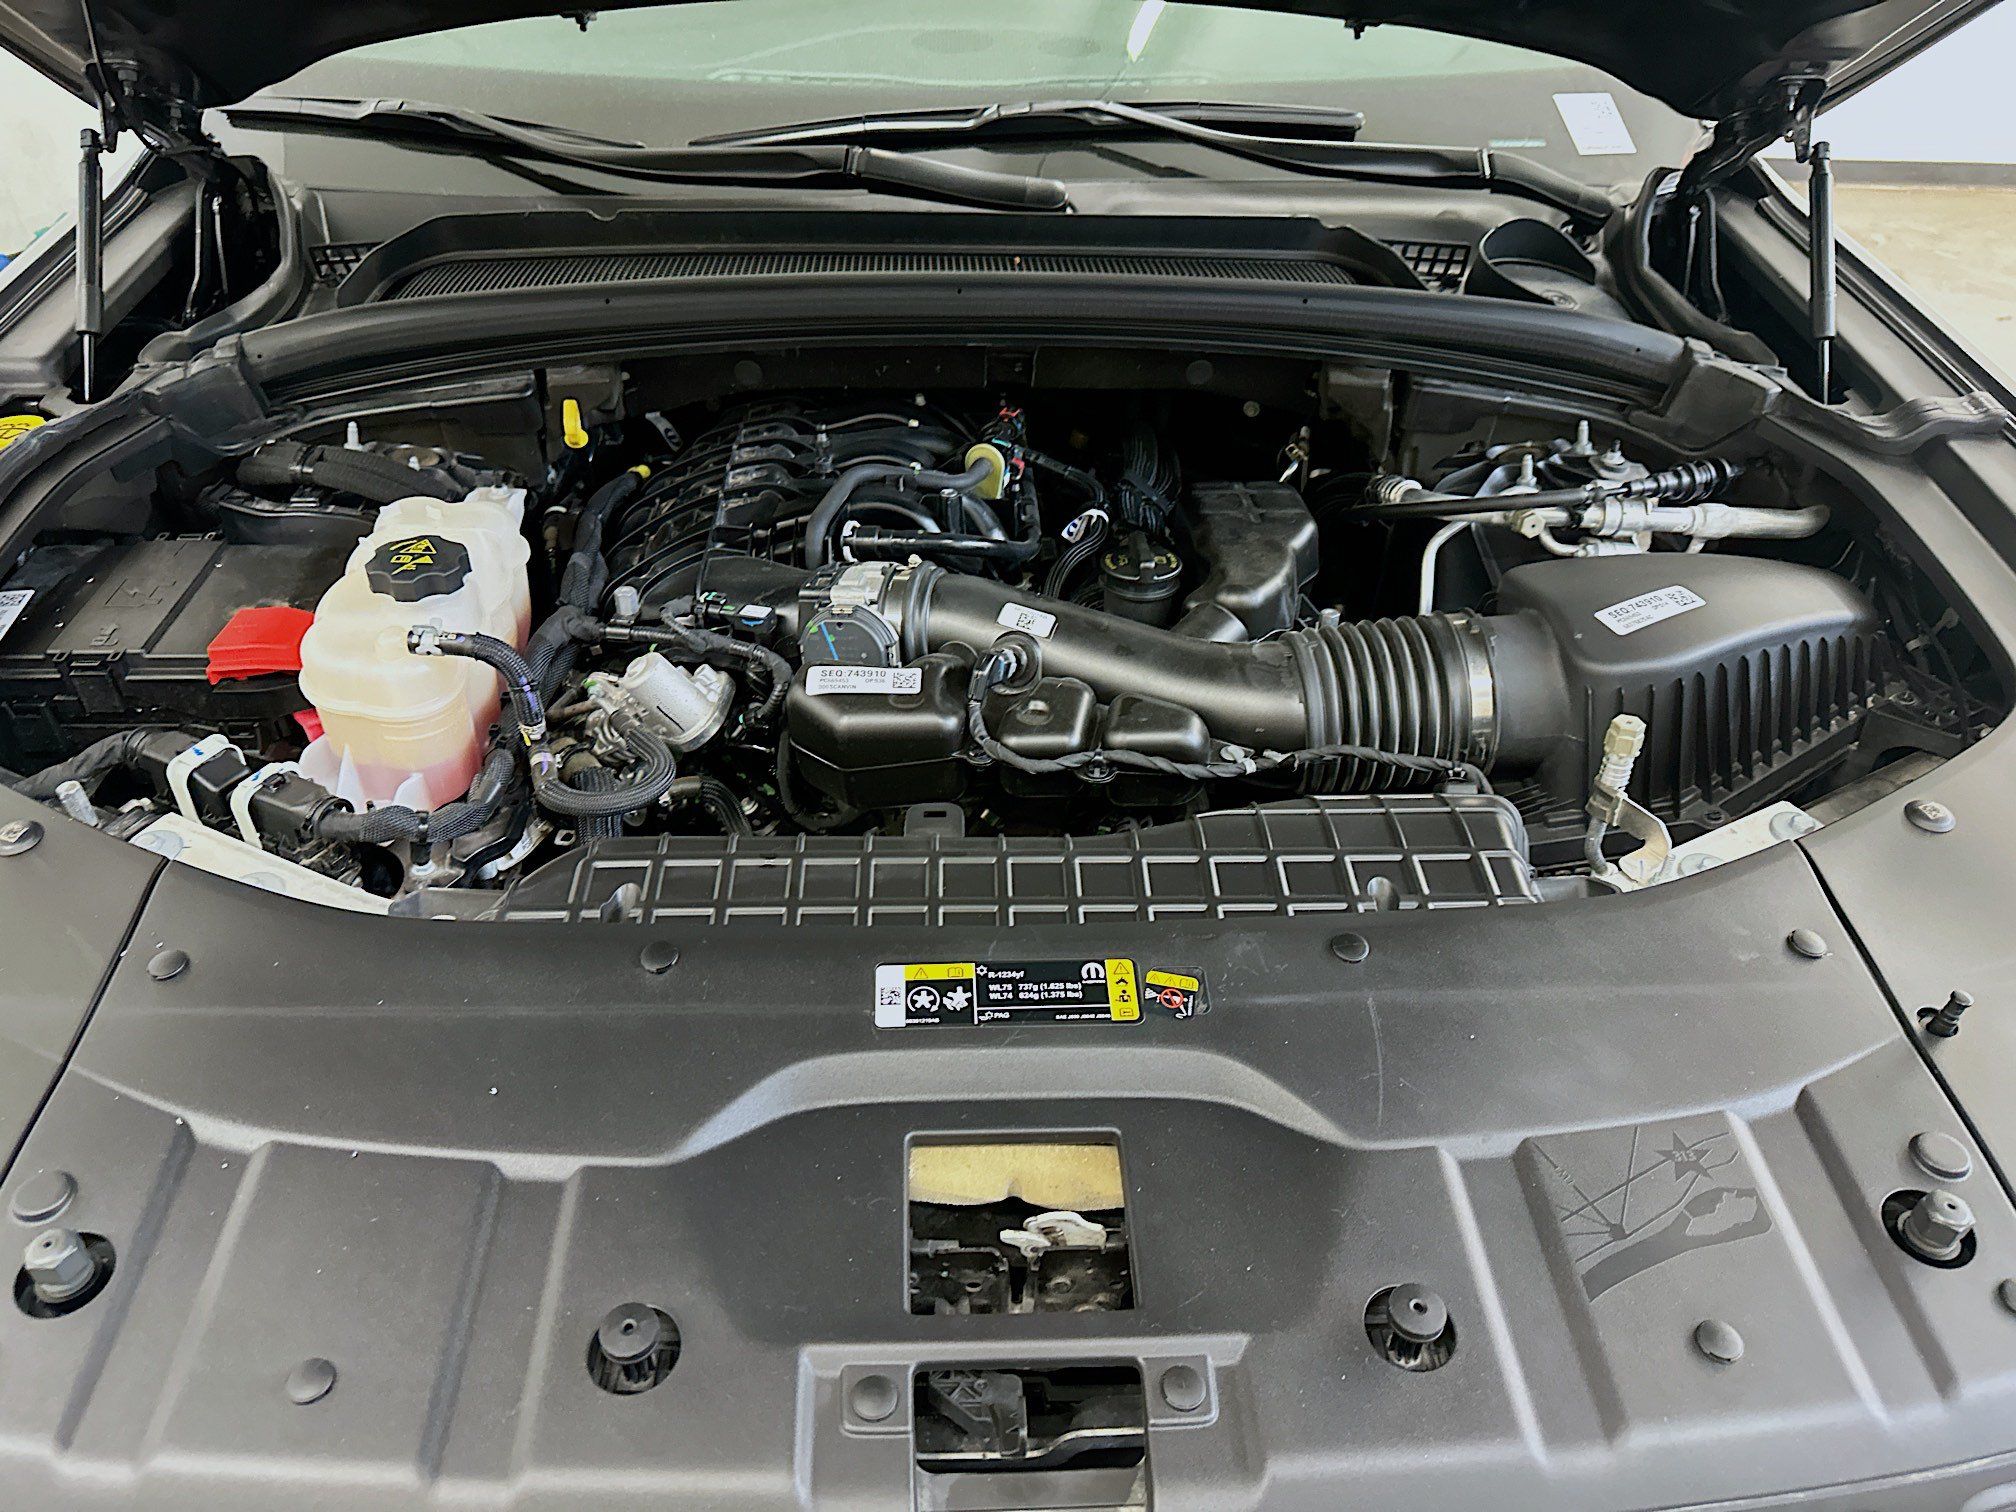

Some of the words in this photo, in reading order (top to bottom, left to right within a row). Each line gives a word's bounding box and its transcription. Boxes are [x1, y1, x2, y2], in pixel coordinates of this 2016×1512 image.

[820, 669, 887, 678] SEQ:743910
[988, 970, 1025, 980] R-1234yf
[989, 983, 1013, 991] WL75
[1018, 983, 1038, 992] 737g
[989, 992, 1013, 1000] WL74
